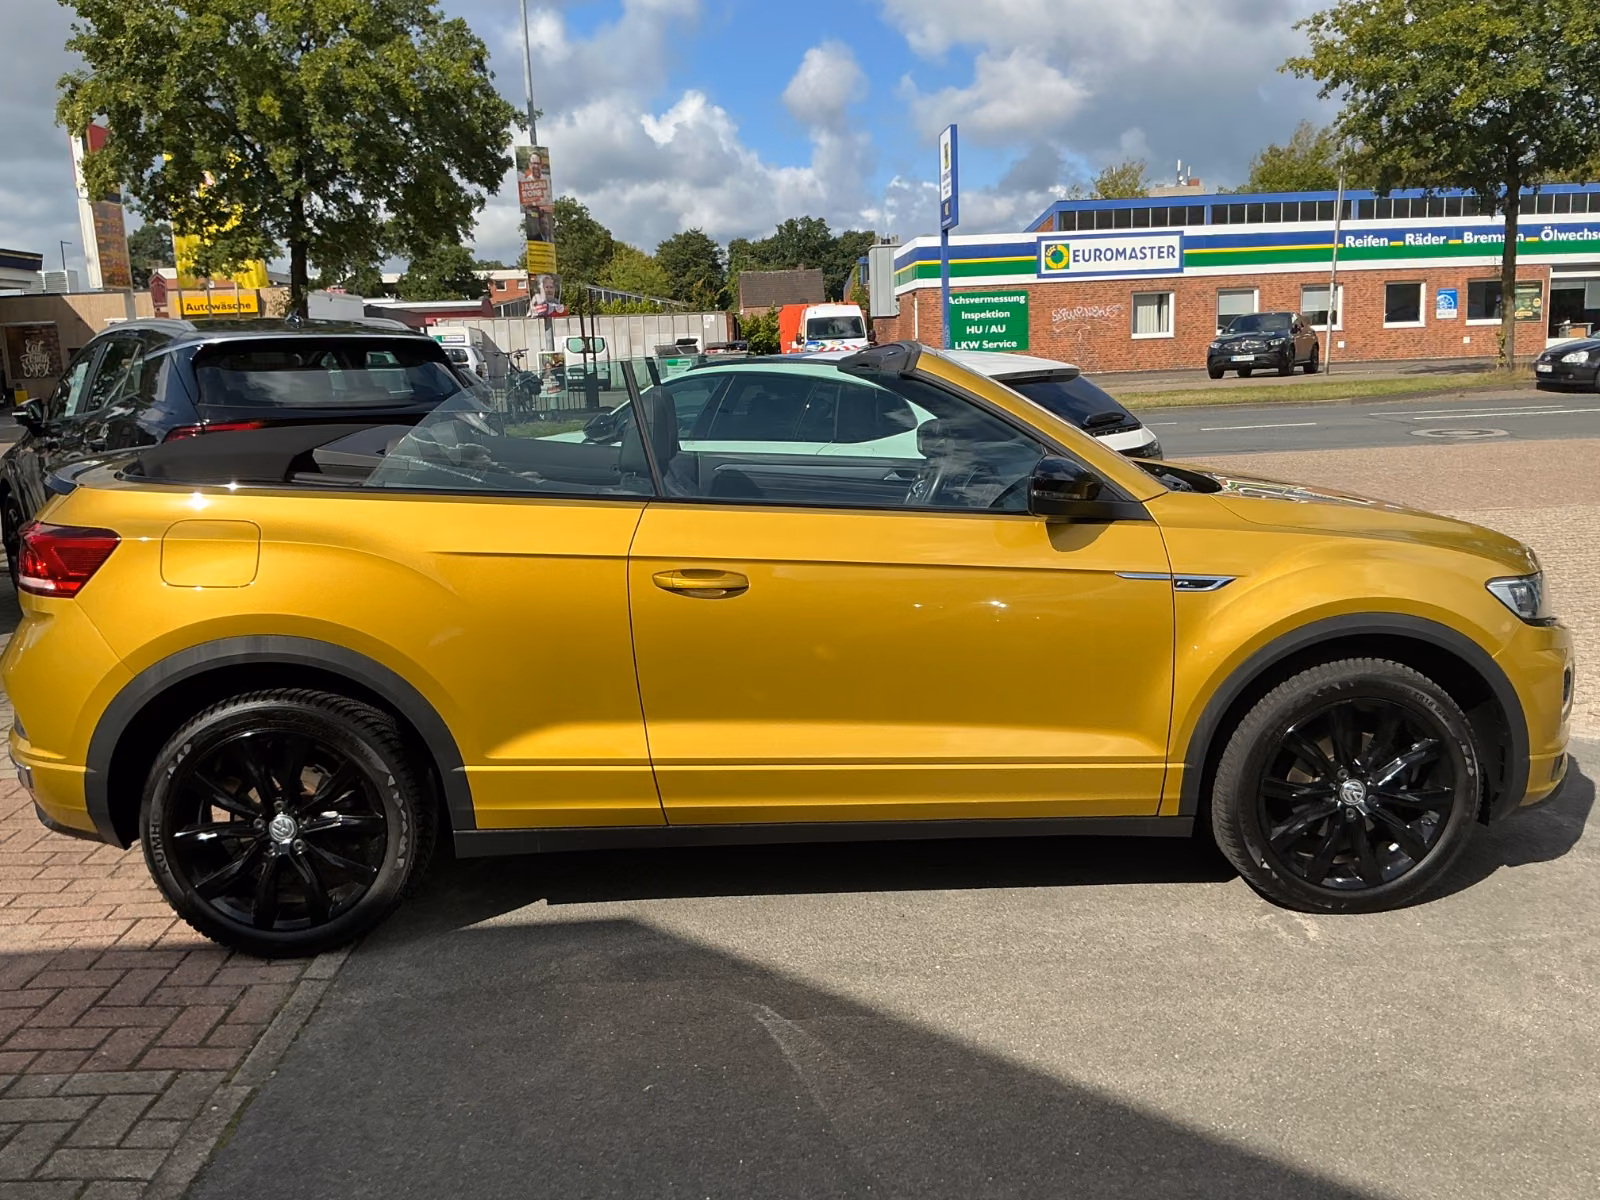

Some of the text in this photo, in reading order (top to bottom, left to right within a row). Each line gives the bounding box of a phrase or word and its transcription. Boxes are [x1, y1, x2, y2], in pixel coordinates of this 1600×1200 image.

[1345, 226, 1600, 248] Reifen Räder Bremsn Ölwechs
[1072, 245, 1176, 263] EUROMASTER
[949, 295, 1026, 305] Achsvermessung
[186, 301, 252, 312] Autowäsche
[961, 309, 1010, 321] Inspektion
[966, 325, 983, 335] HU
[990, 324, 1007, 334] AU
[955, 339, 1018, 350] LKW Service
